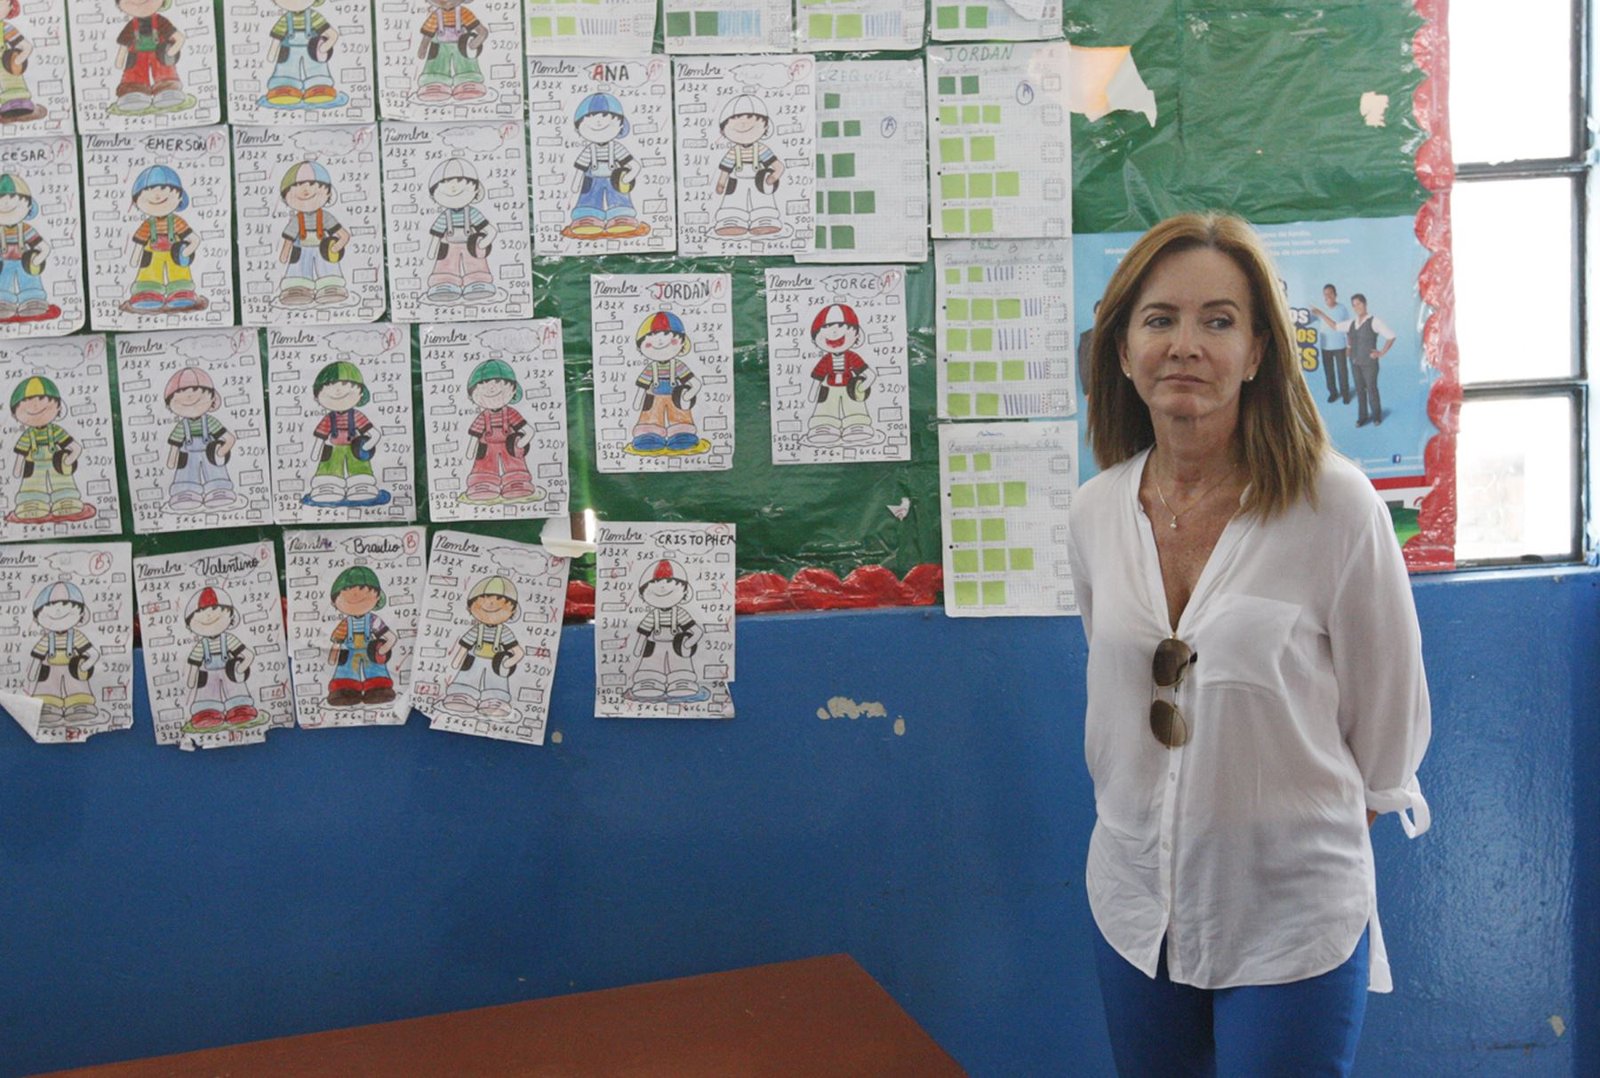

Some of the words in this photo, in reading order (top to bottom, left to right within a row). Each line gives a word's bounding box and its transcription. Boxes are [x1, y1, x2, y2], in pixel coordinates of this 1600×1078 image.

[944, 44, 1014, 62] JORDAN
[592, 64, 629, 81] ANA
[832, 277, 875, 290] JORGE
[1289, 308, 1309, 325] OS
[1296, 328, 1317, 344] OS
[353, 536, 400, 554] Braulio
[657, 534, 736, 545] CRISTOPHER
[197, 553, 259, 575] Valentino
